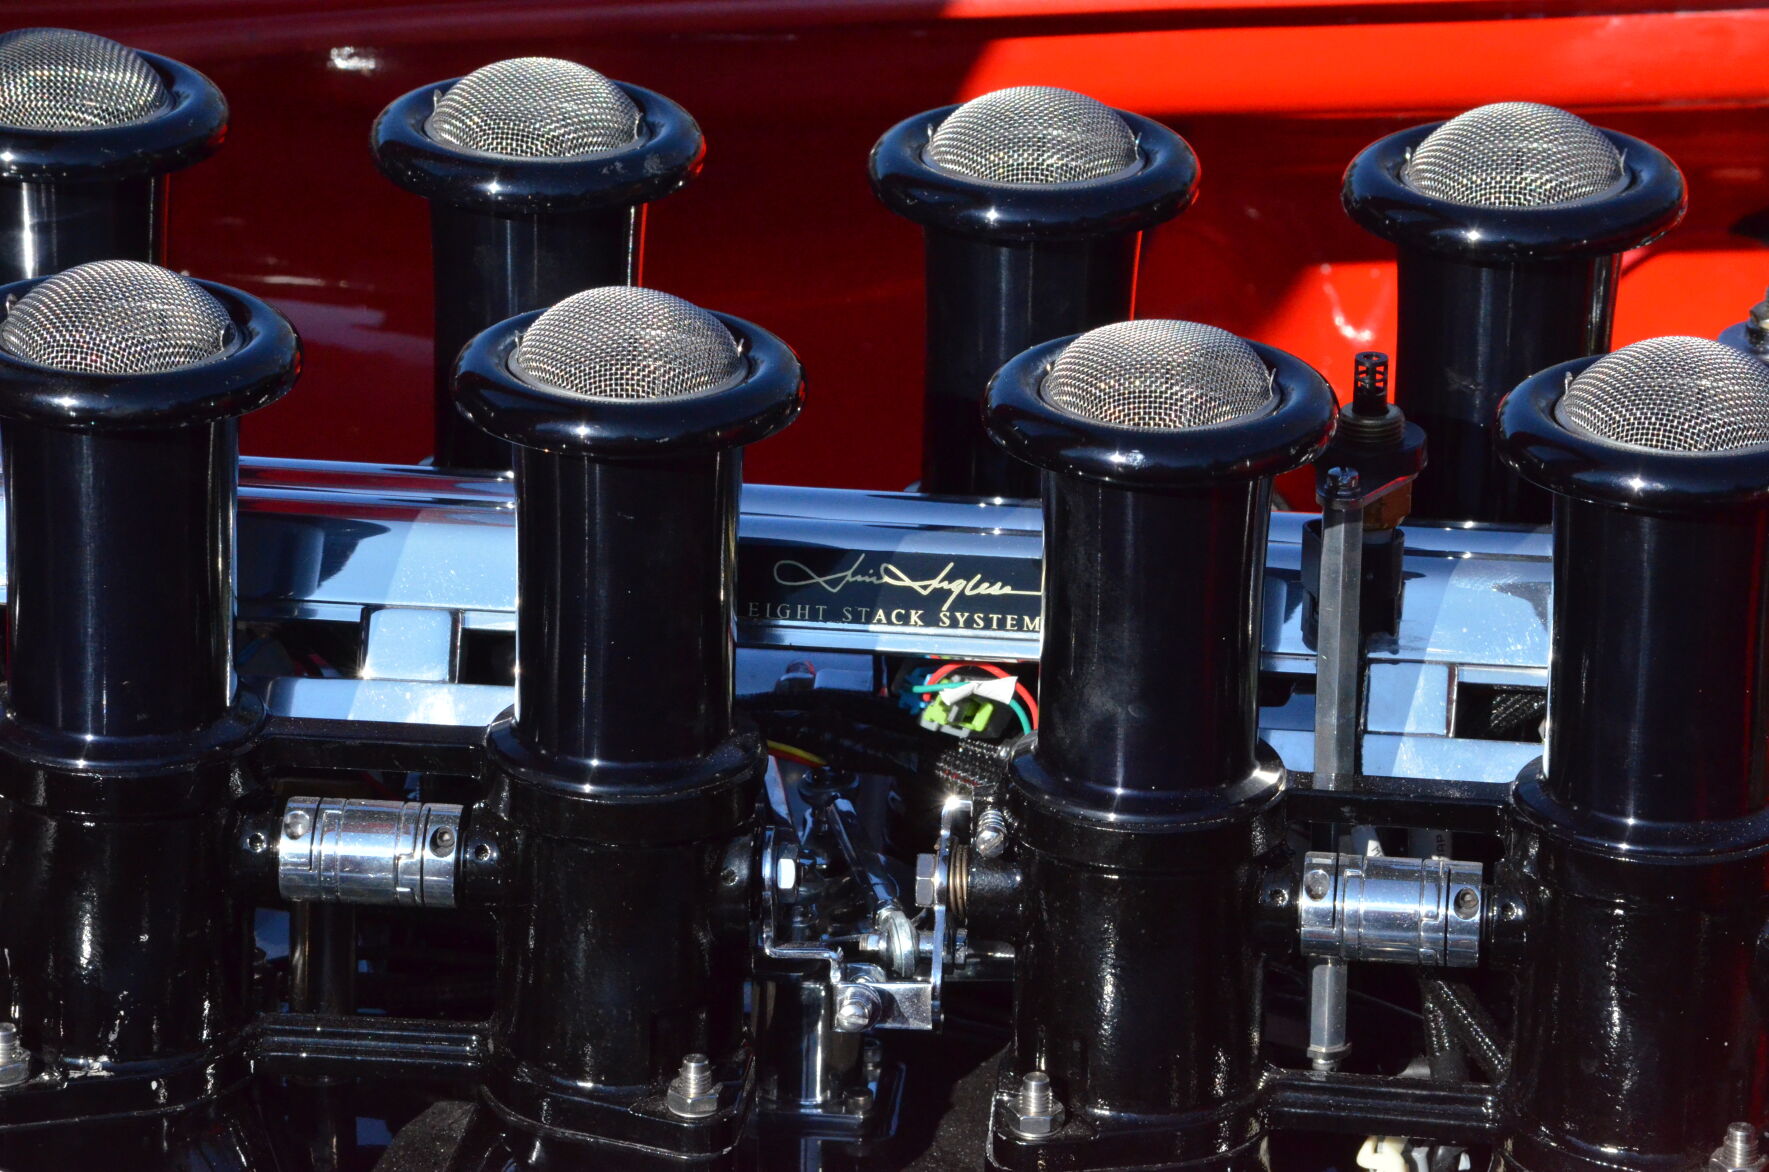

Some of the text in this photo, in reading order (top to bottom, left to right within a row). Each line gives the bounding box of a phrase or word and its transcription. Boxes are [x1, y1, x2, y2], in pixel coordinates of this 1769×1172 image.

[747, 601, 1041, 632] EIGHT STACK SYSTEM
